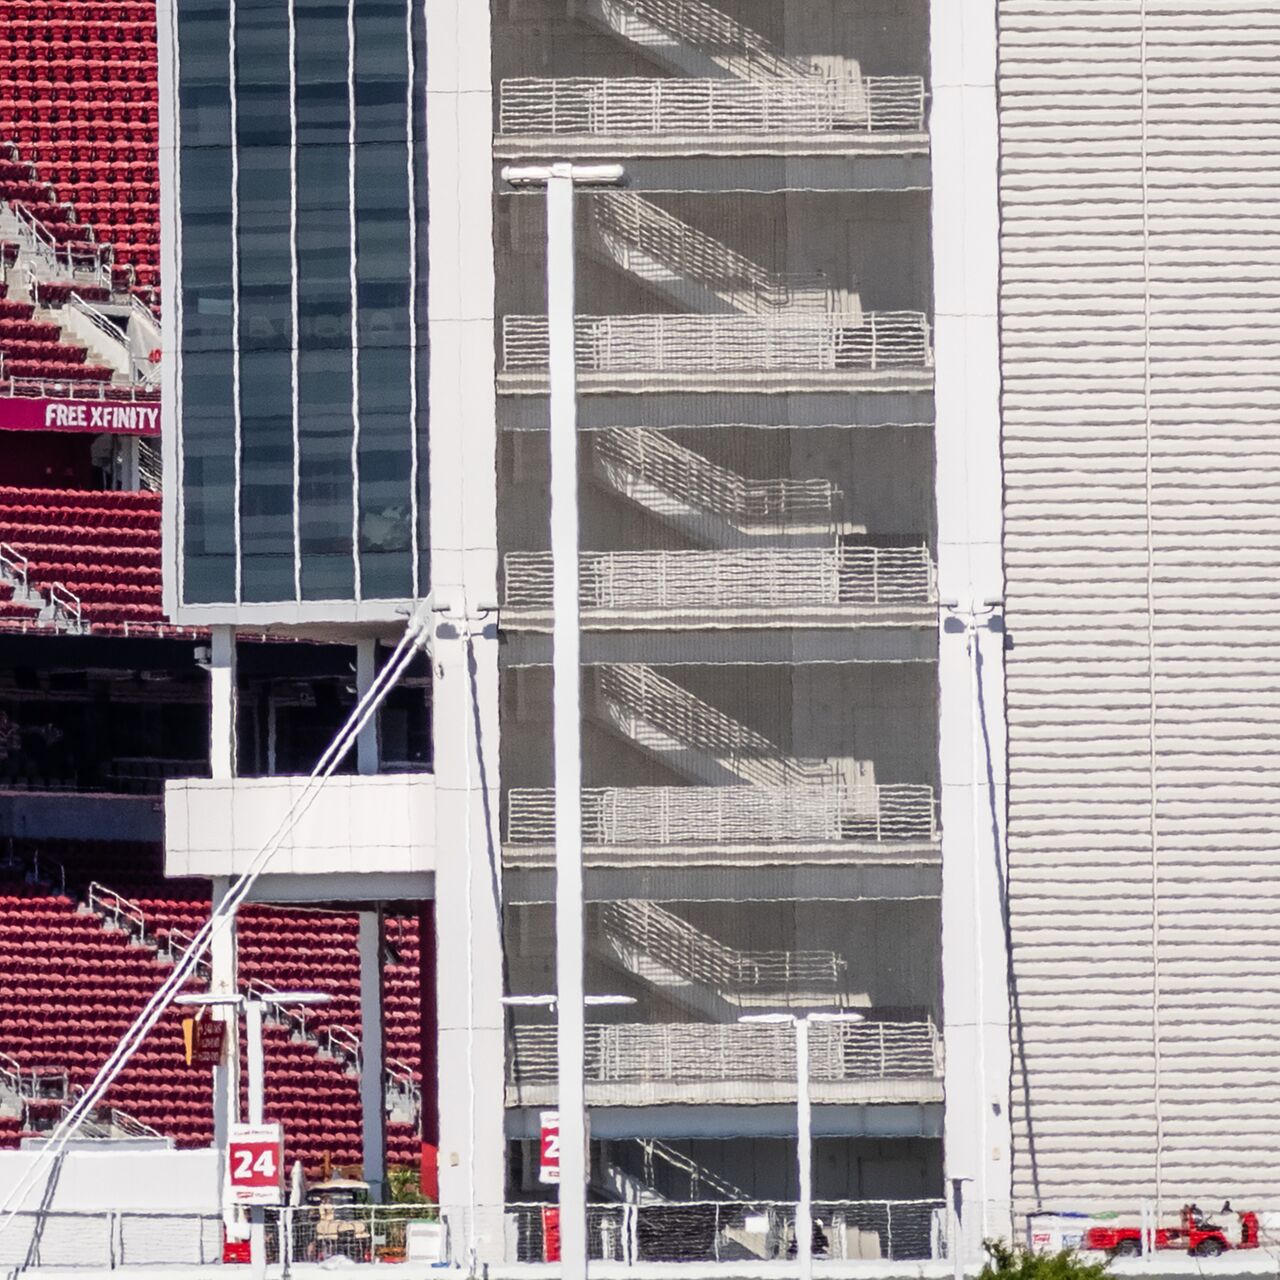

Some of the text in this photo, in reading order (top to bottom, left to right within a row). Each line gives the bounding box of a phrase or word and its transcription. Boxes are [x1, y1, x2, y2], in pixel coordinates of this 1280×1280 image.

[148, 349, 162, 364] 40
[44, 403, 159, 429] FREE XFINITY
[544, 1134, 559, 1158] 2
[234, 1150, 277, 1179] 24
